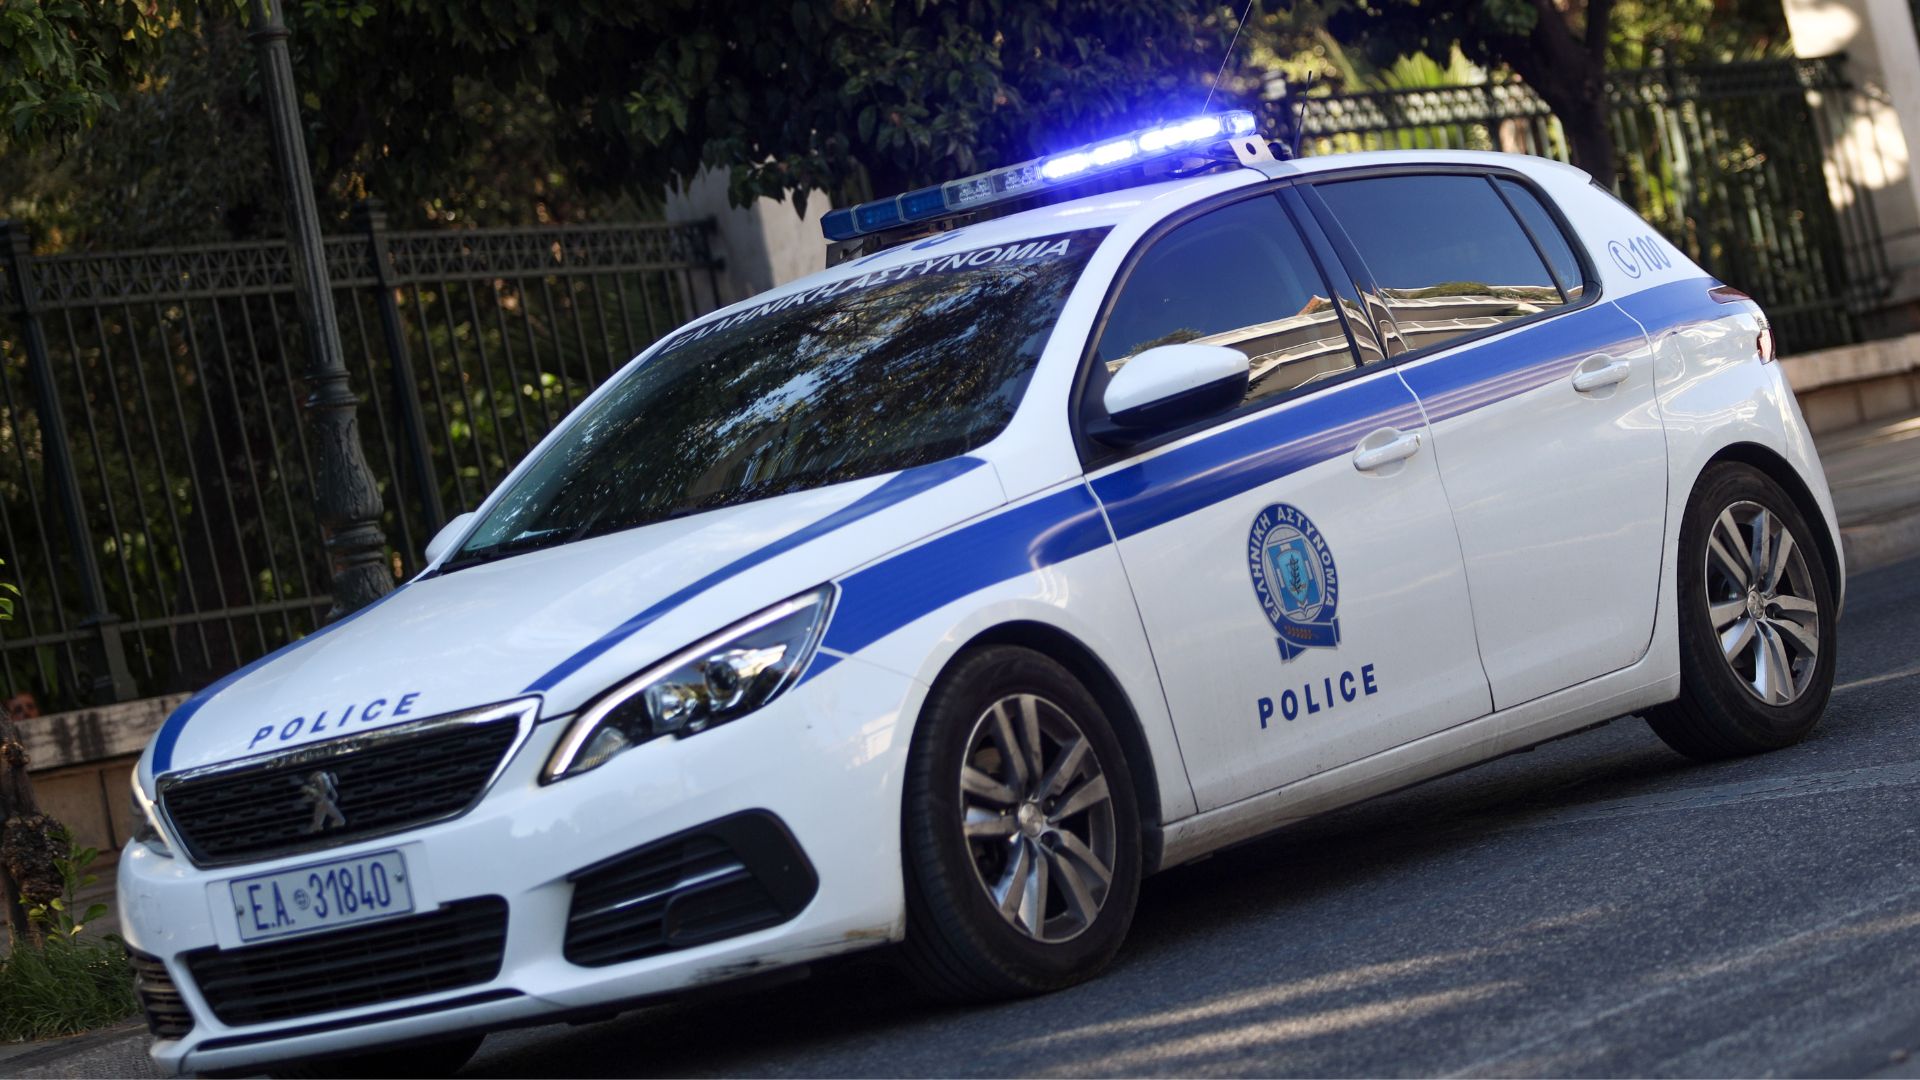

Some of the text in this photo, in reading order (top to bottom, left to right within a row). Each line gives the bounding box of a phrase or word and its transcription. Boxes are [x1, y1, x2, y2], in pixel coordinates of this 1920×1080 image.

[841, 238, 1071, 293] ΑΣΤΥΝΟΜΙΑ
[1627, 235, 1672, 272] 100
[1249, 505, 1337, 624] ΕΛΛΗΝΙΚΗ ΑΣΤΥΝΟΜΙΑ
[247, 692, 421, 750] POLICE
[1257, 663, 1379, 730] POLICE
[308, 862, 392, 919] 31840
